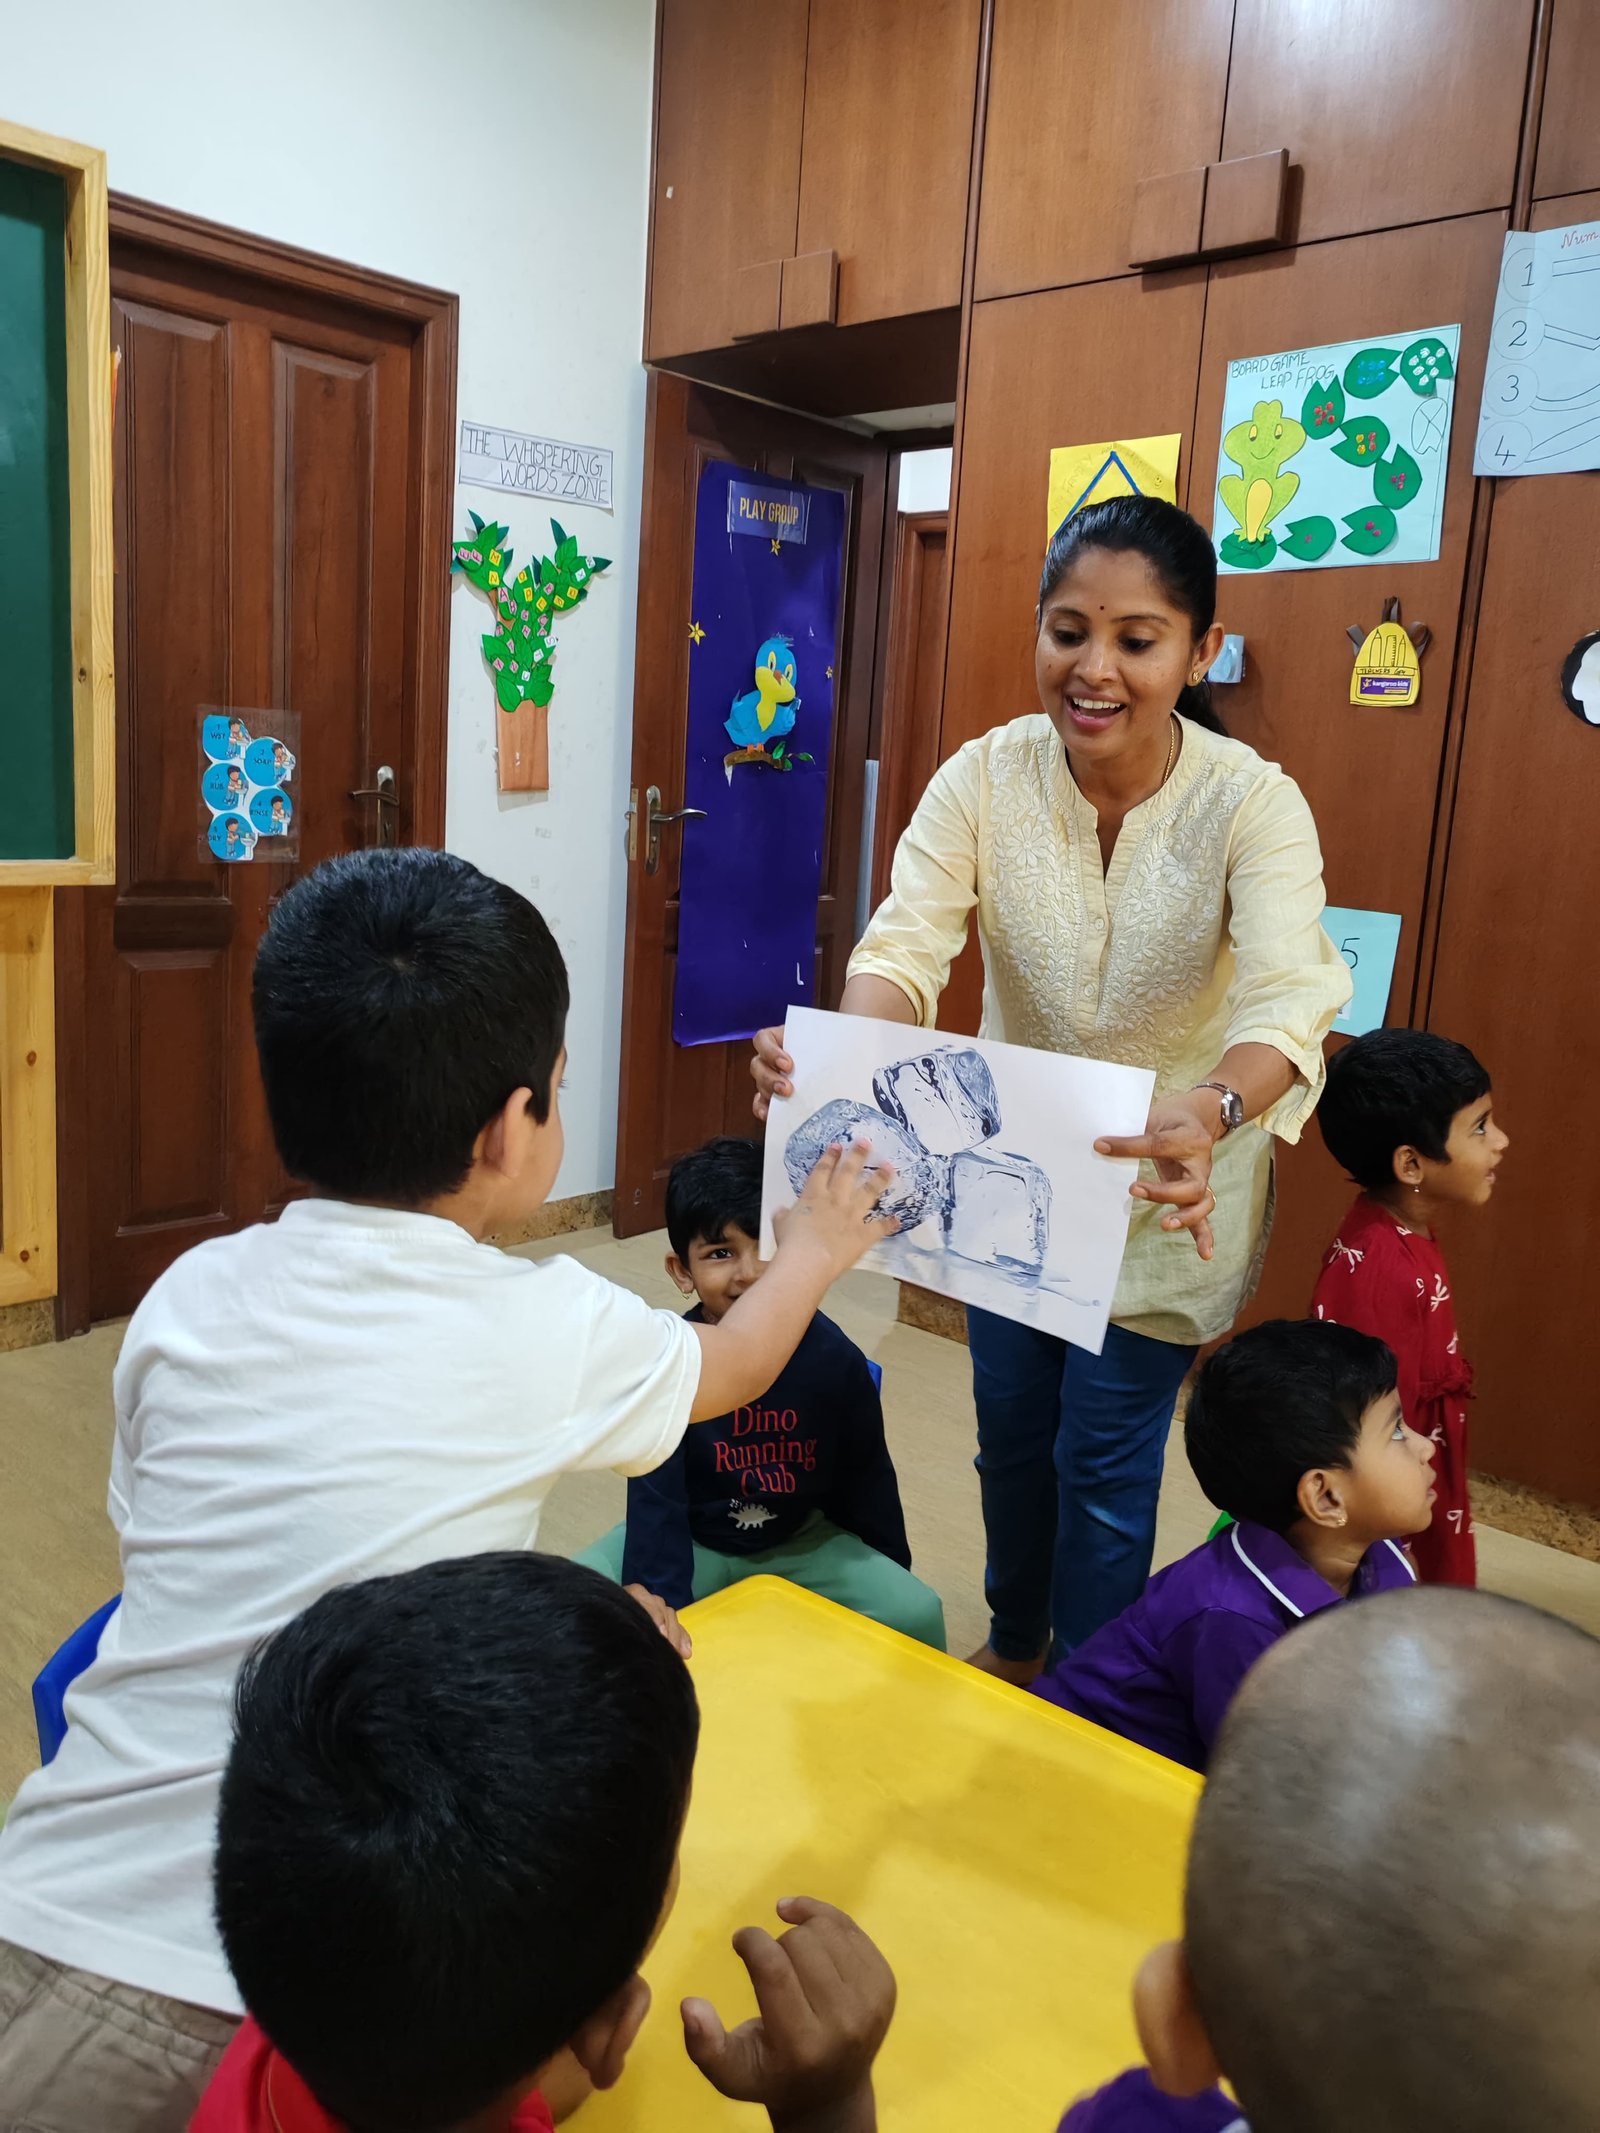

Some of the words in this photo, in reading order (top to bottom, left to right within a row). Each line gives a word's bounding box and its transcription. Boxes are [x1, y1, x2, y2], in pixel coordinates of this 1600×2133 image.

[1521, 262, 1535, 287] 1
[1508, 320, 1527, 347] 2
[1231, 359, 1269, 379] BOARD
[1270, 352, 1310, 372] GAME
[1261, 371, 1292, 389] LEAP
[1295, 364, 1335, 390] FROG
[1501, 374, 1519, 402] 3
[465, 428, 491, 456] THE
[502, 434, 603, 476] WHISPERING
[1495, 435, 1516, 466] 4
[501, 462, 558, 495] WORDS
[562, 473, 609, 504] ZONE
[740, 497, 766, 521] PLAY
[768, 502, 799, 525] GROUP
[1341, 937, 1360, 969] 5
[732, 1404, 798, 1437] Dino
[713, 1434, 817, 1473] Running
[741, 1463, 796, 1498] Club
